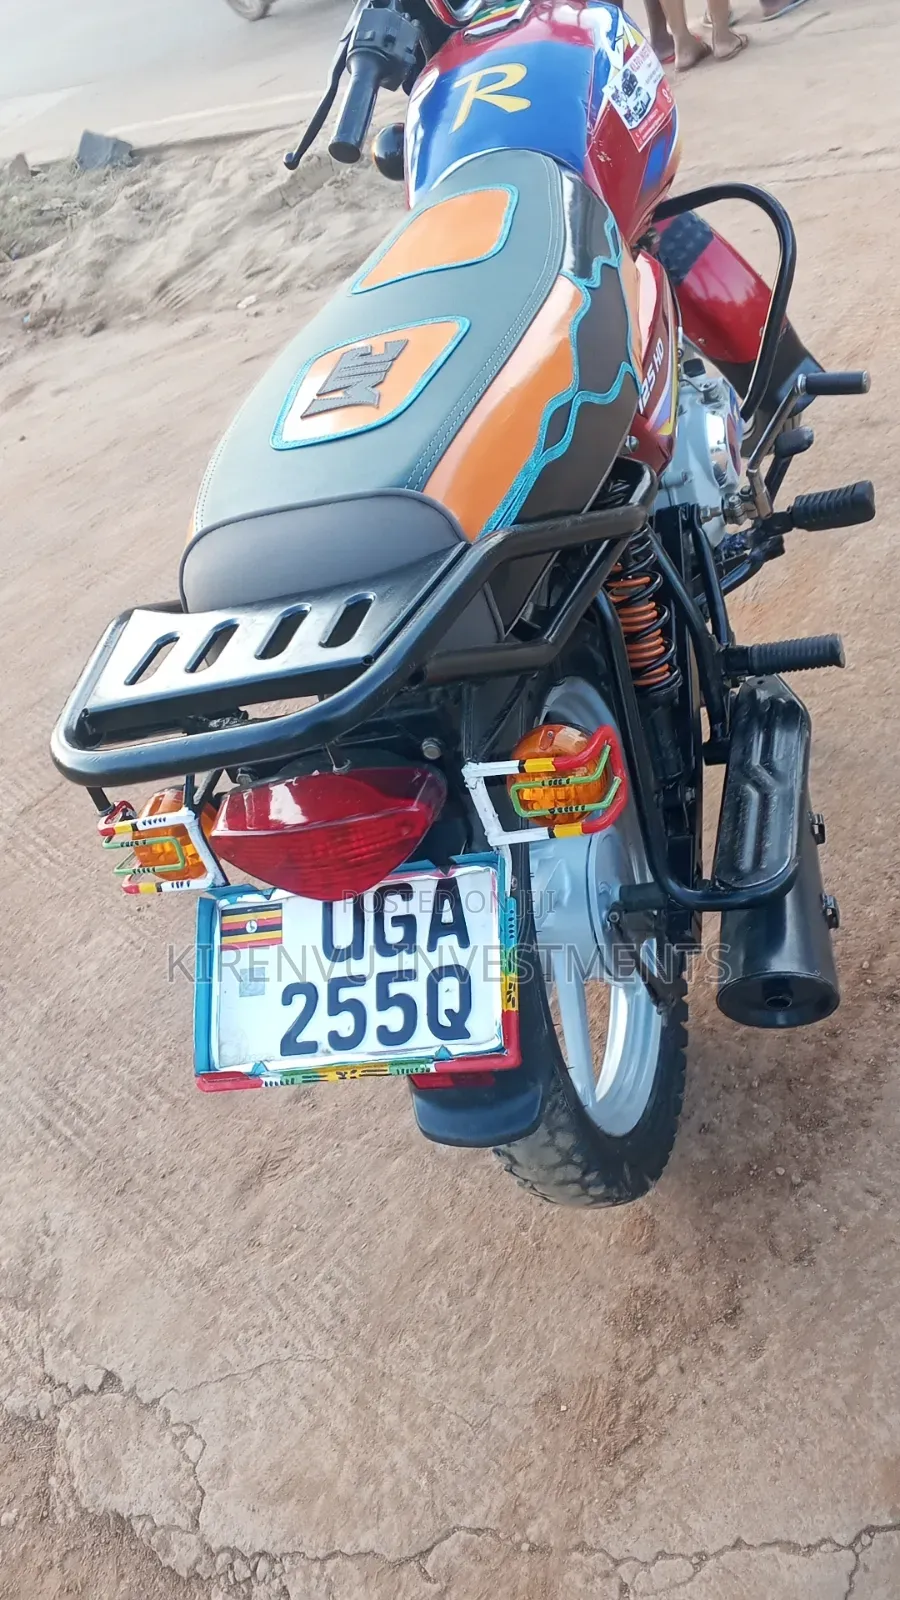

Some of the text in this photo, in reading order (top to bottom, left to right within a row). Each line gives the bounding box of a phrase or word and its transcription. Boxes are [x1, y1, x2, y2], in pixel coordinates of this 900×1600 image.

[449, 62, 532, 136] R
[639, 337, 664, 415] 125 HD
[322, 876, 471, 963] UGA
[279, 963, 473, 1058] 255Q
